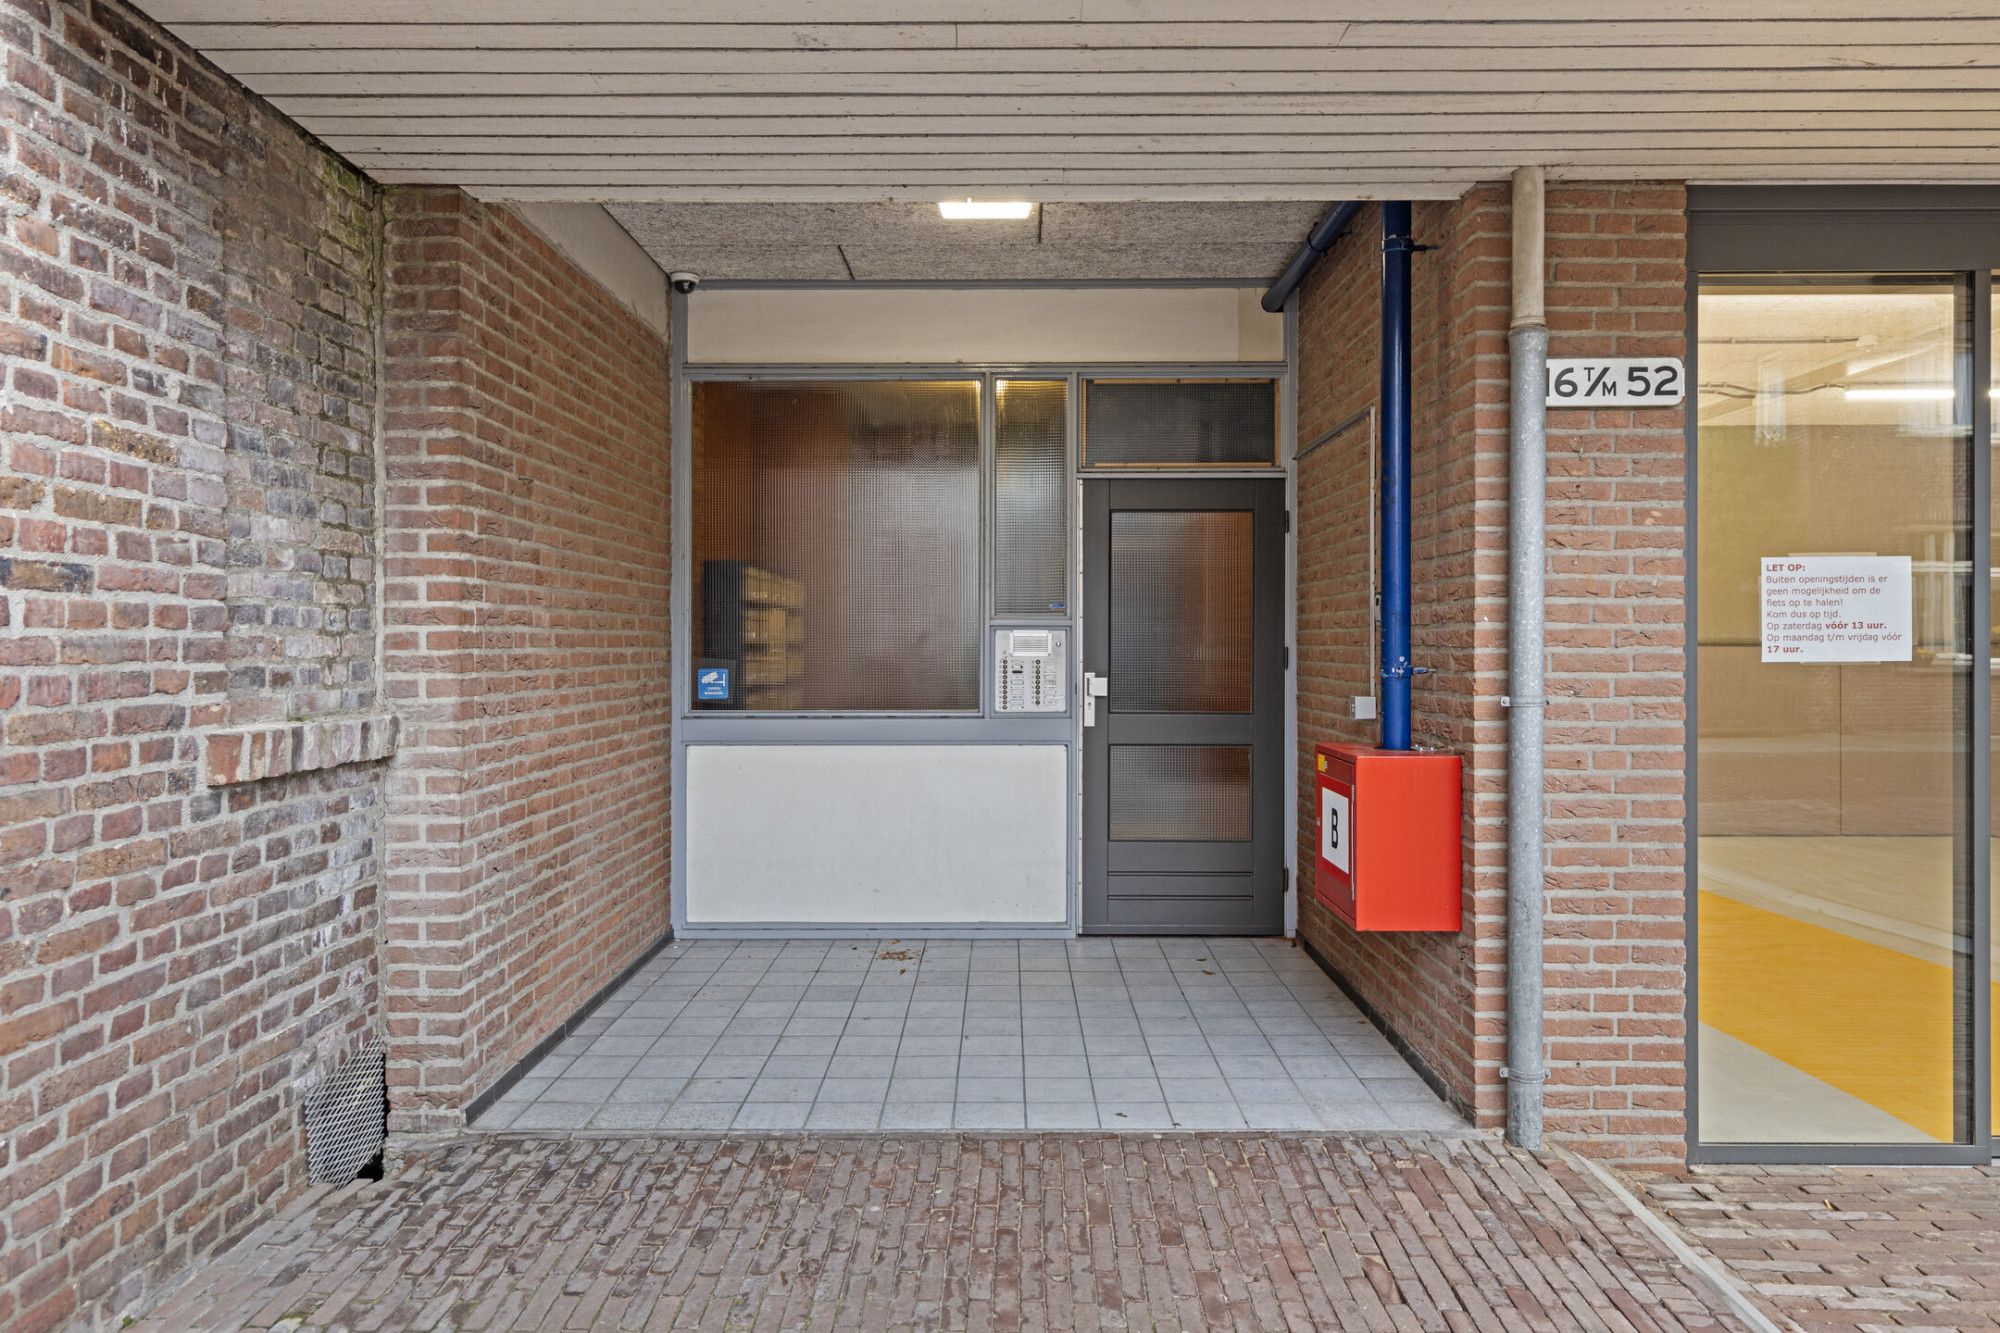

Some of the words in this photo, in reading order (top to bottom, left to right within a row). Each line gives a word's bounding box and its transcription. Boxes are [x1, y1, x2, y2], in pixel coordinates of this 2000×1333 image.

[1584, 367, 1616, 396] T/M
[1627, 366, 1678, 396] 52
[1799, 575, 1864, 584] openingstijden
[1792, 587, 1849, 596] mogelijkheid
[1791, 610, 1806, 618] dus
[1824, 610, 1841, 619] tijd.
[1767, 623, 1779, 631] Op
[1783, 622, 1822, 631] zaterdag
[1767, 634, 1779, 643] Op
[1783, 634, 1824, 642] maandag
[1848, 633, 1878, 642] vrijdag
[1331, 807, 1338, 849] B
